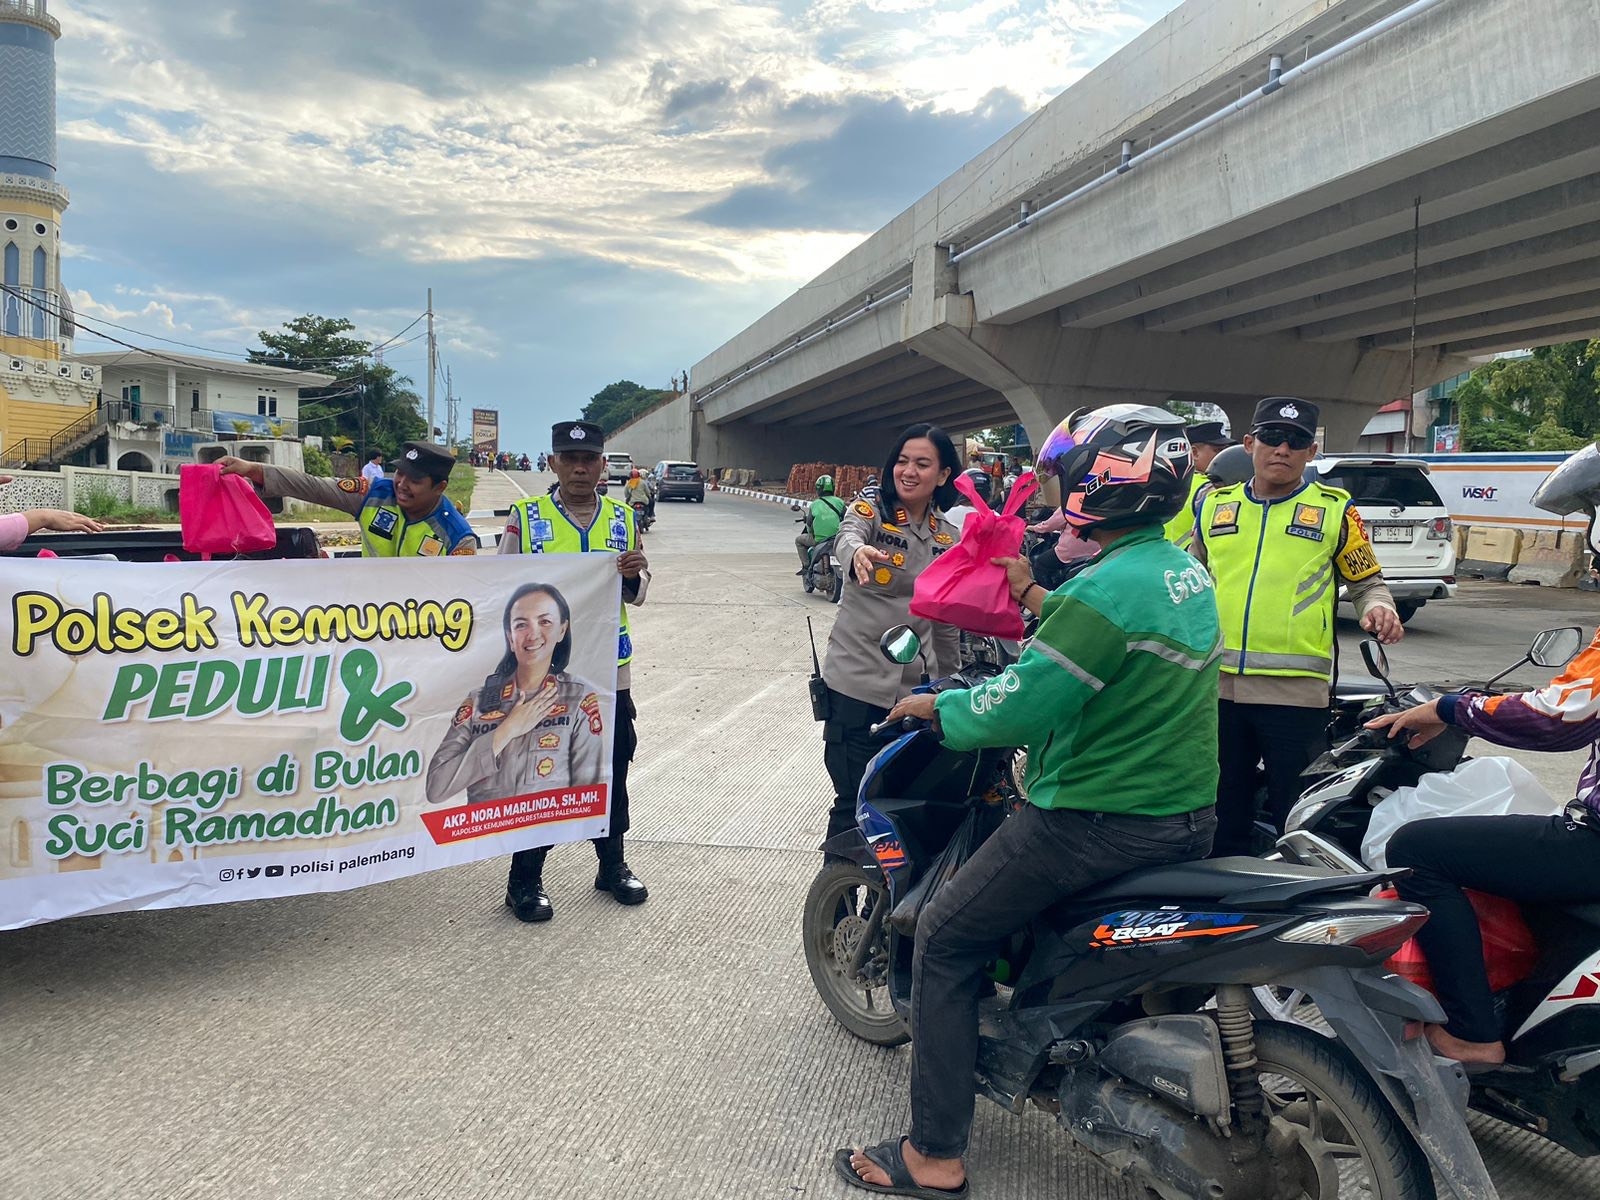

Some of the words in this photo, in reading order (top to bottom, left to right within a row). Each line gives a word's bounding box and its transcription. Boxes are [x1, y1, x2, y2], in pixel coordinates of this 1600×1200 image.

[1167, 442, 1188, 452] GM
[1086, 467, 1111, 495] GM
[1463, 487, 1498, 499] WSKT
[607, 540, 627, 551] POLISI
[876, 531, 908, 550] NORA
[1290, 527, 1322, 540] POLRI
[1164, 557, 1212, 605] Grab
[12, 591, 219, 657] Polsek
[230, 590, 473, 652] Kemuning
[102, 654, 331, 720] PEDULI
[339, 648, 413, 742] &
[47, 761, 238, 809] Berbagi
[256, 753, 295, 793] di
[314, 744, 420, 789] Bulan
[45, 813, 144, 855] Suci
[165, 796, 395, 845] Ramadhan
[443, 815, 469, 830] AKP.
[471, 809, 501, 823] NORA
[503, 796, 560, 817] MARLINDA,
[451, 825, 483, 837] KAPOLSEK
[483, 819, 515, 832] KEMUNING
[515, 810, 555, 826] POLRESTABES
[555, 805, 592, 818] PALEMBANG
[290, 860, 334, 877] polisi
[338, 846, 415, 873] palembang
